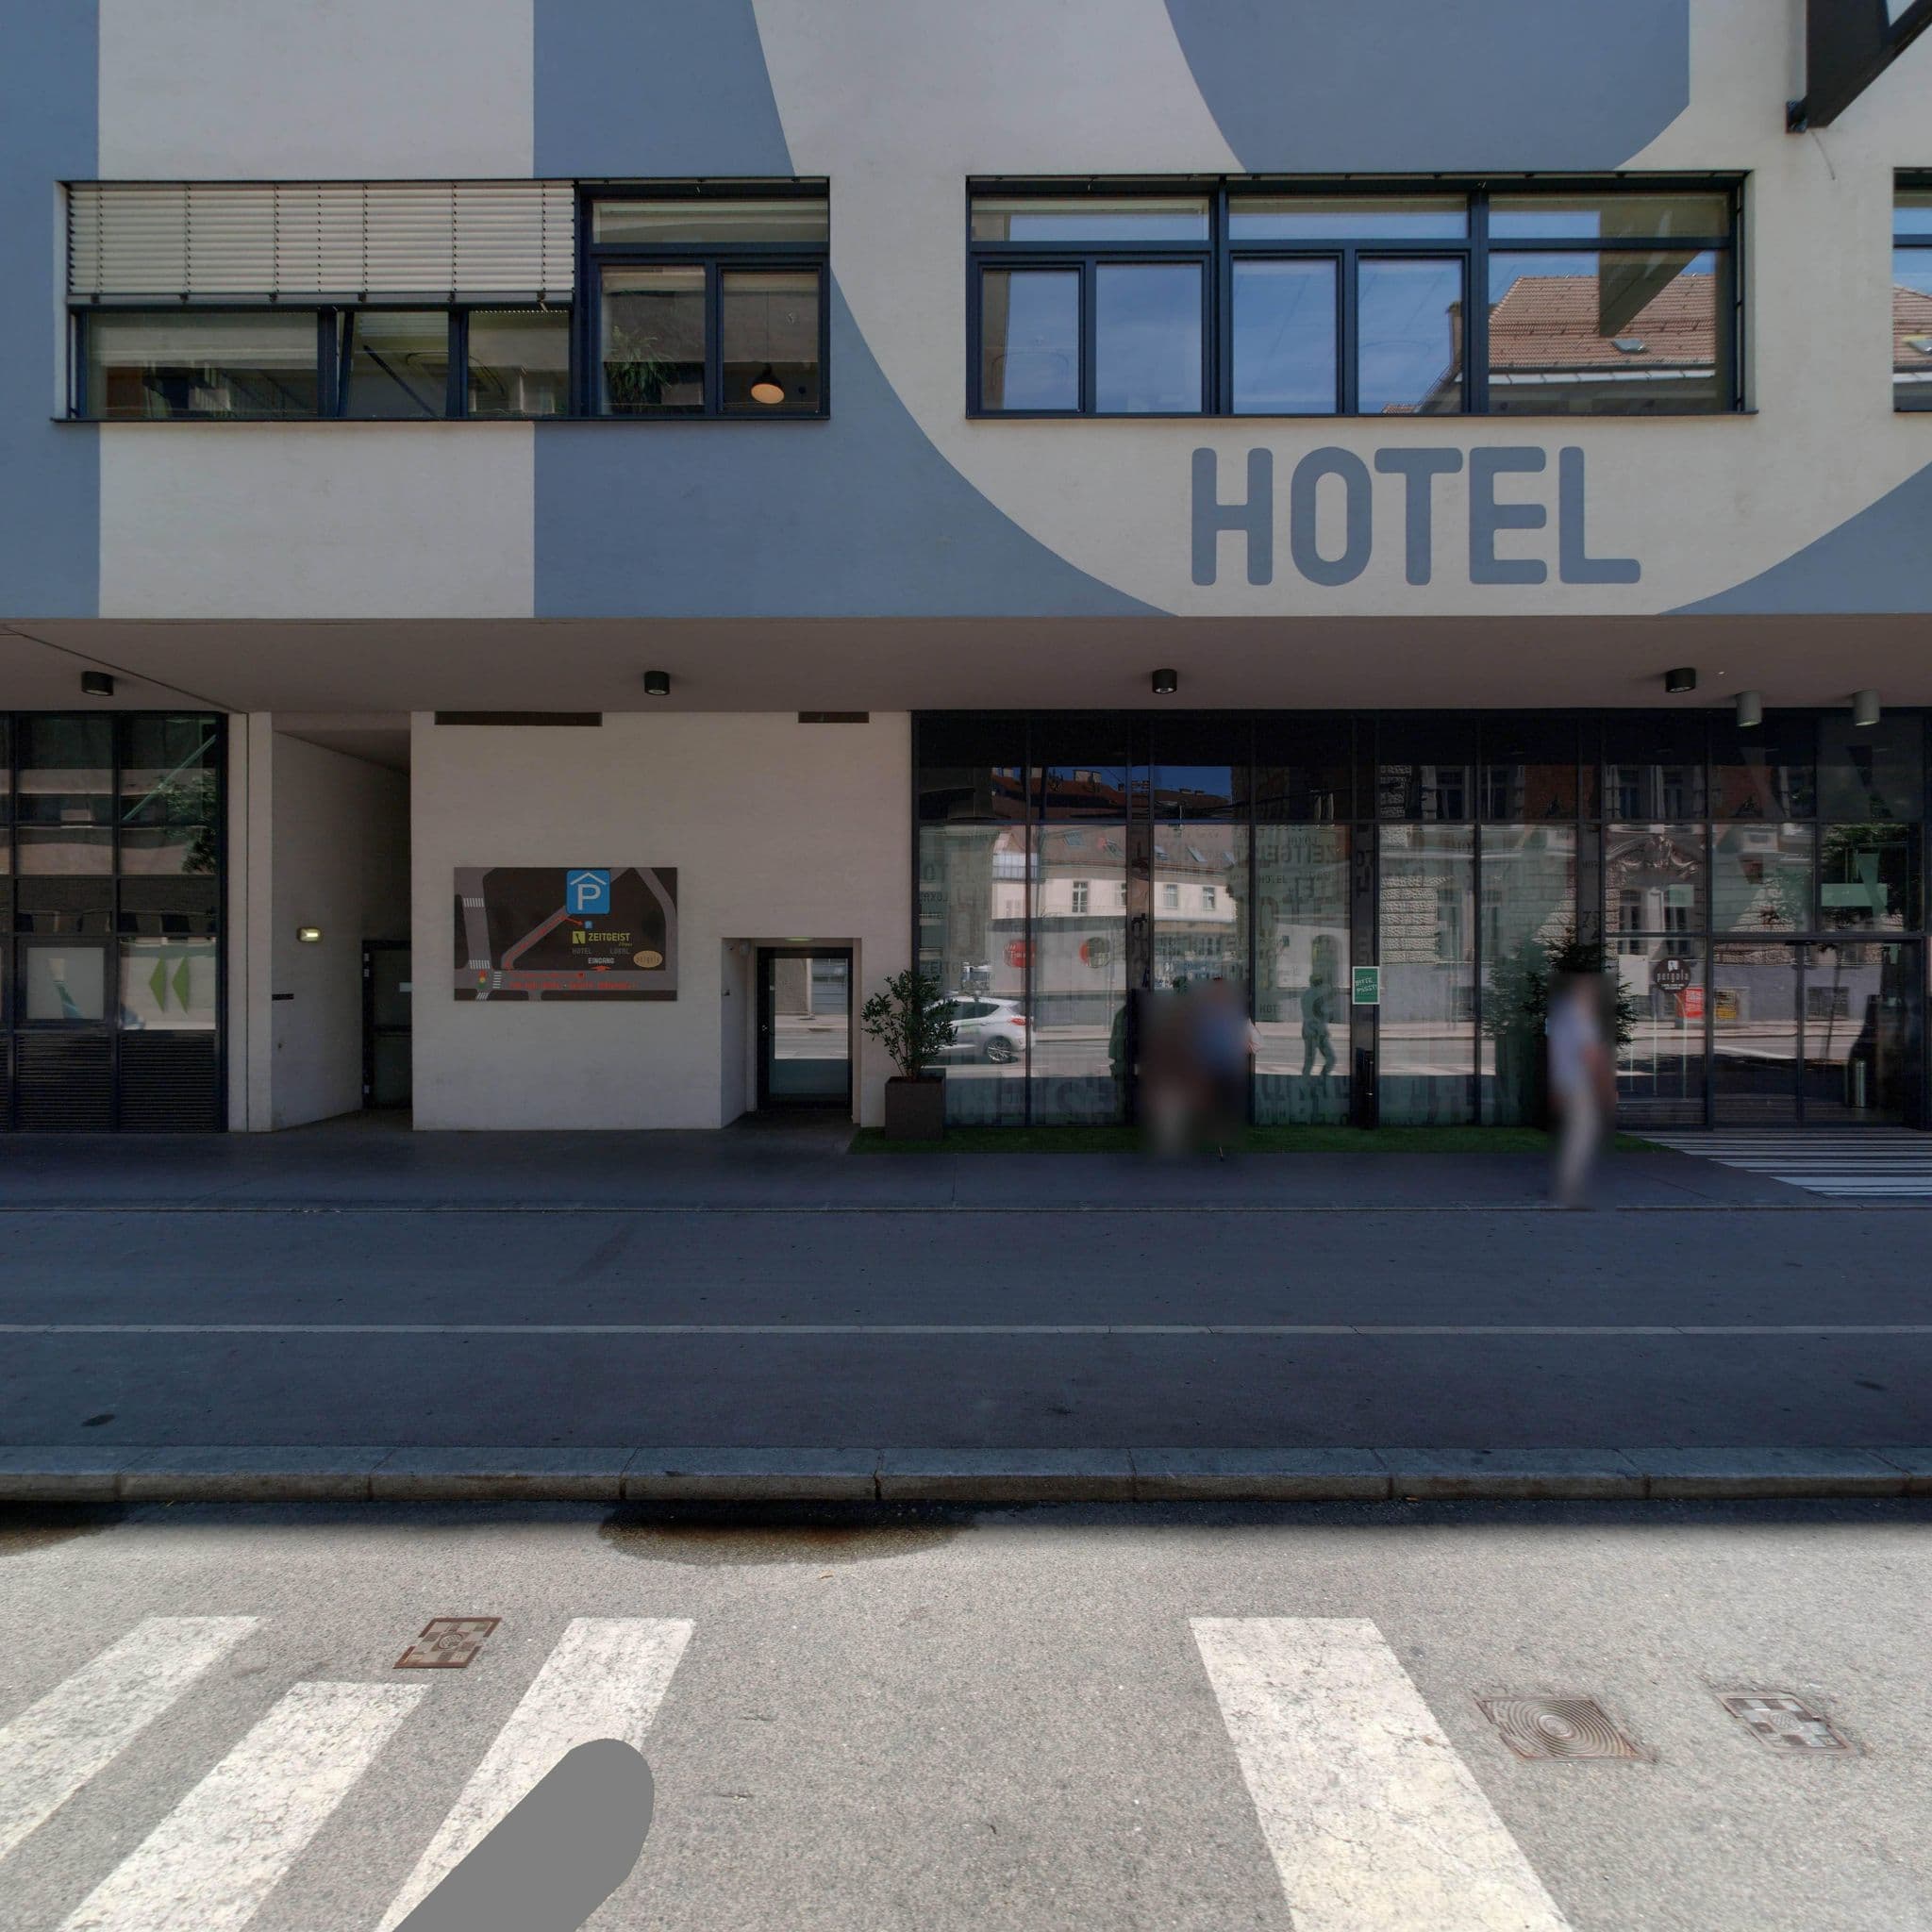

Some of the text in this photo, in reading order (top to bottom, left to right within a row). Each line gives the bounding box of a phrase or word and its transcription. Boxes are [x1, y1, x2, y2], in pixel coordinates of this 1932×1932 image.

[1191, 446, 1641, 587] HOTEL
[577, 884, 601, 911] P
[588, 932, 631, 942] ZEITGEIST
